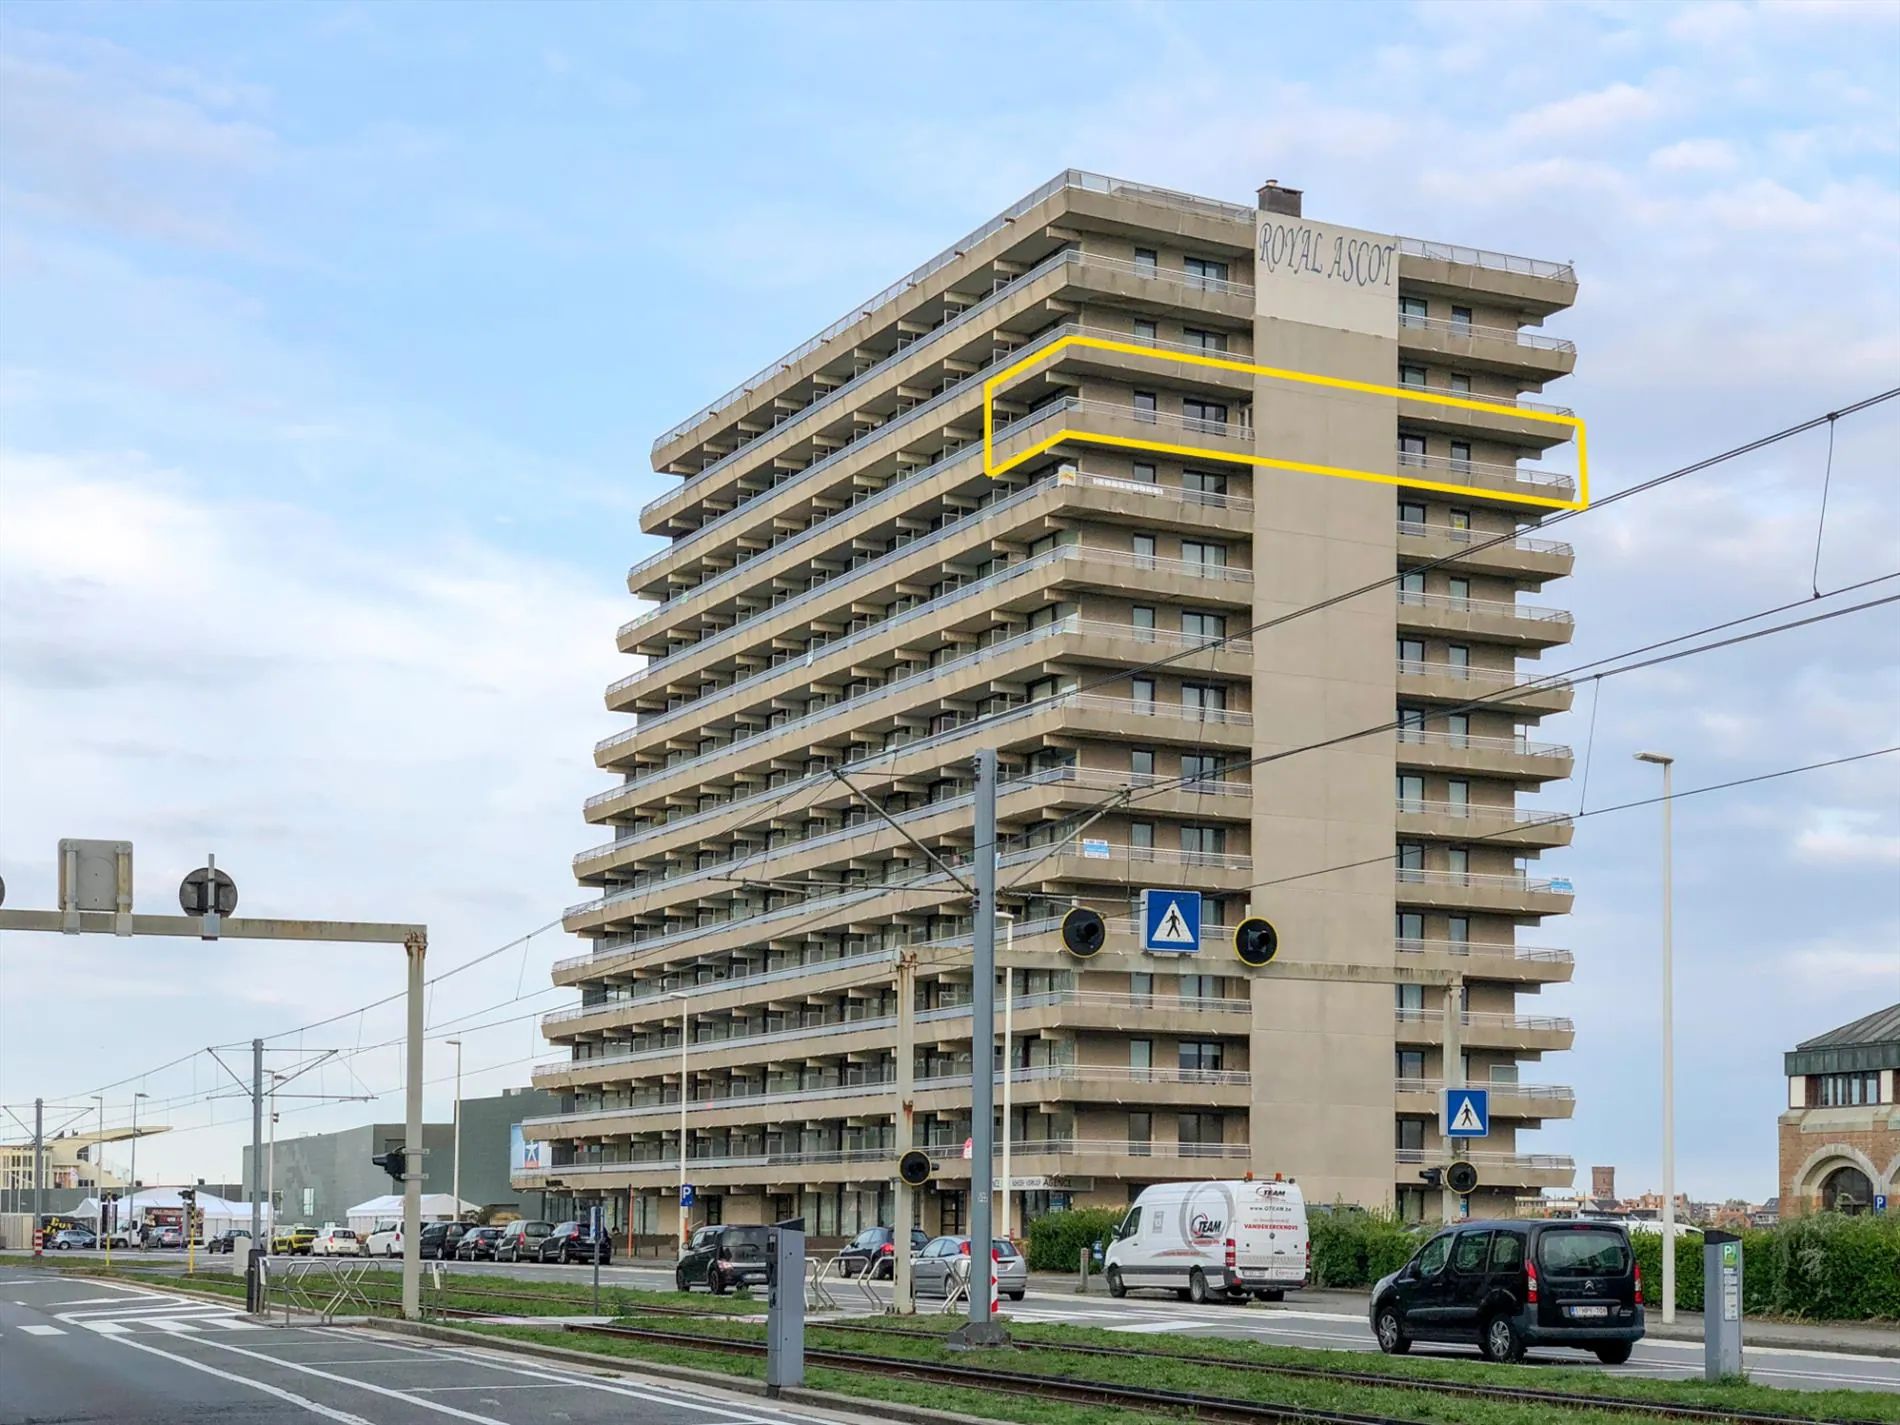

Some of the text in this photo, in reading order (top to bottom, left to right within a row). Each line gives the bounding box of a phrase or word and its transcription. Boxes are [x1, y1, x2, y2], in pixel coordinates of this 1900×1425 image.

[1260, 222, 1397, 287] ROYAL ASCOT
[682, 1186, 692, 1199] P
[1876, 1196, 1885, 1209] P
